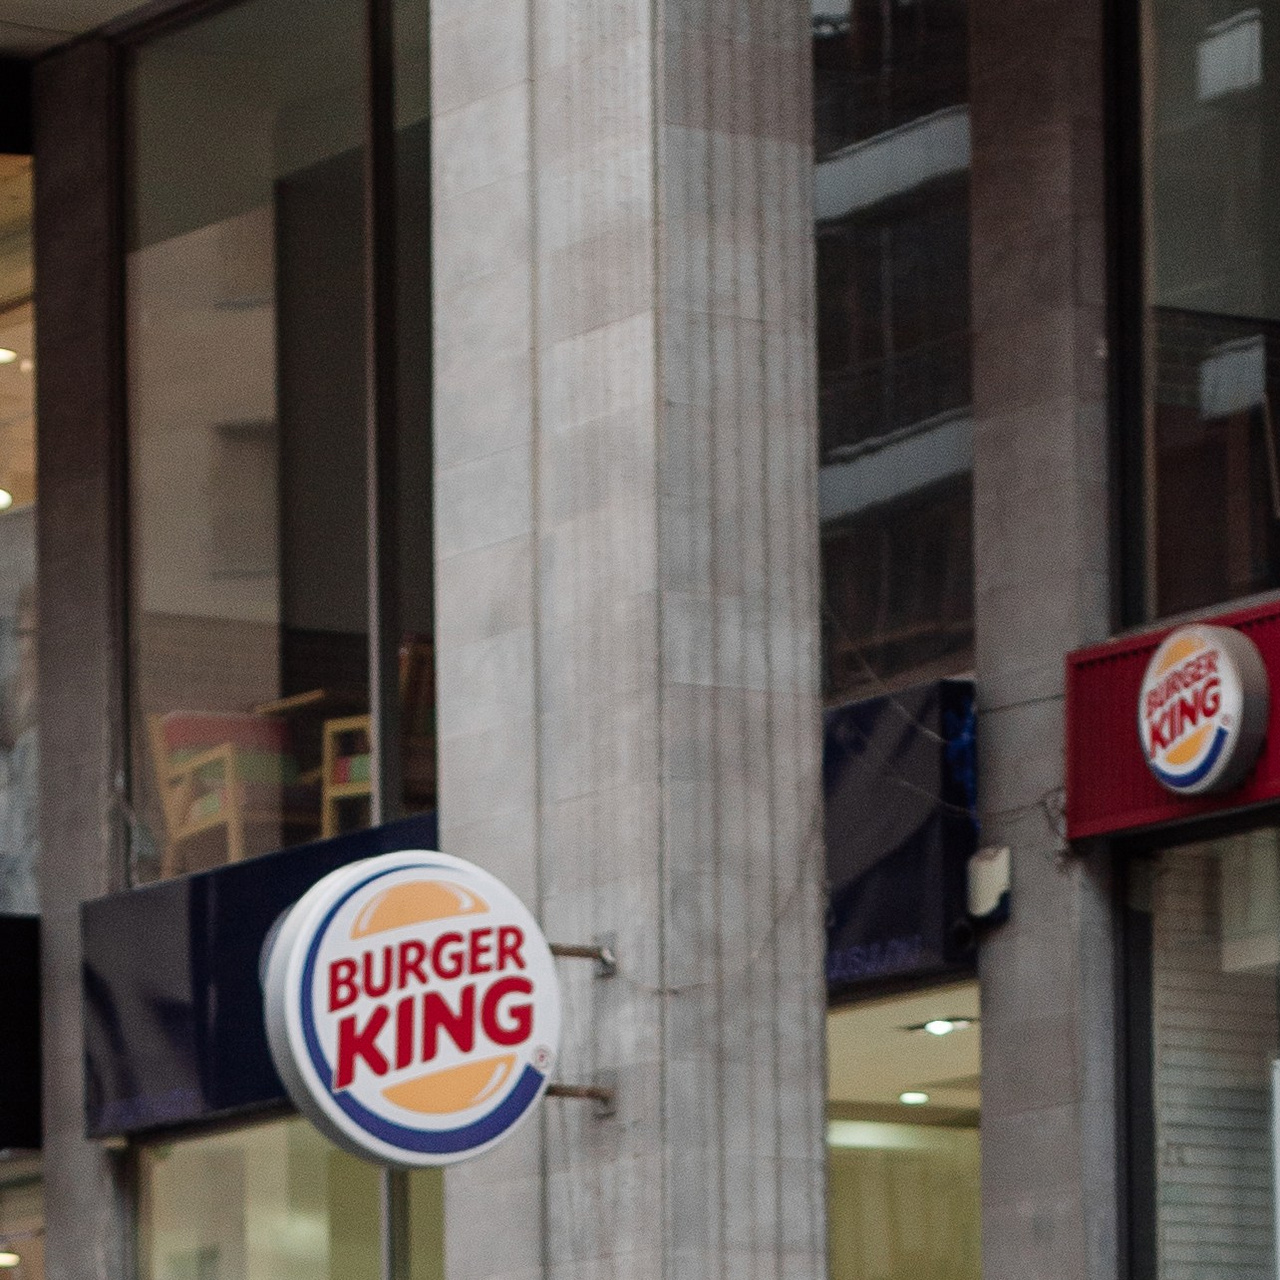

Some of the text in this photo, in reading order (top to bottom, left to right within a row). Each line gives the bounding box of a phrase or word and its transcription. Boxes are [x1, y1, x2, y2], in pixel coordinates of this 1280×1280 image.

[1147, 650, 1219, 719] BURGER
[1150, 677, 1221, 760] KING
[328, 925, 526, 1013] BURGER
[334, 975, 534, 1091] KING
